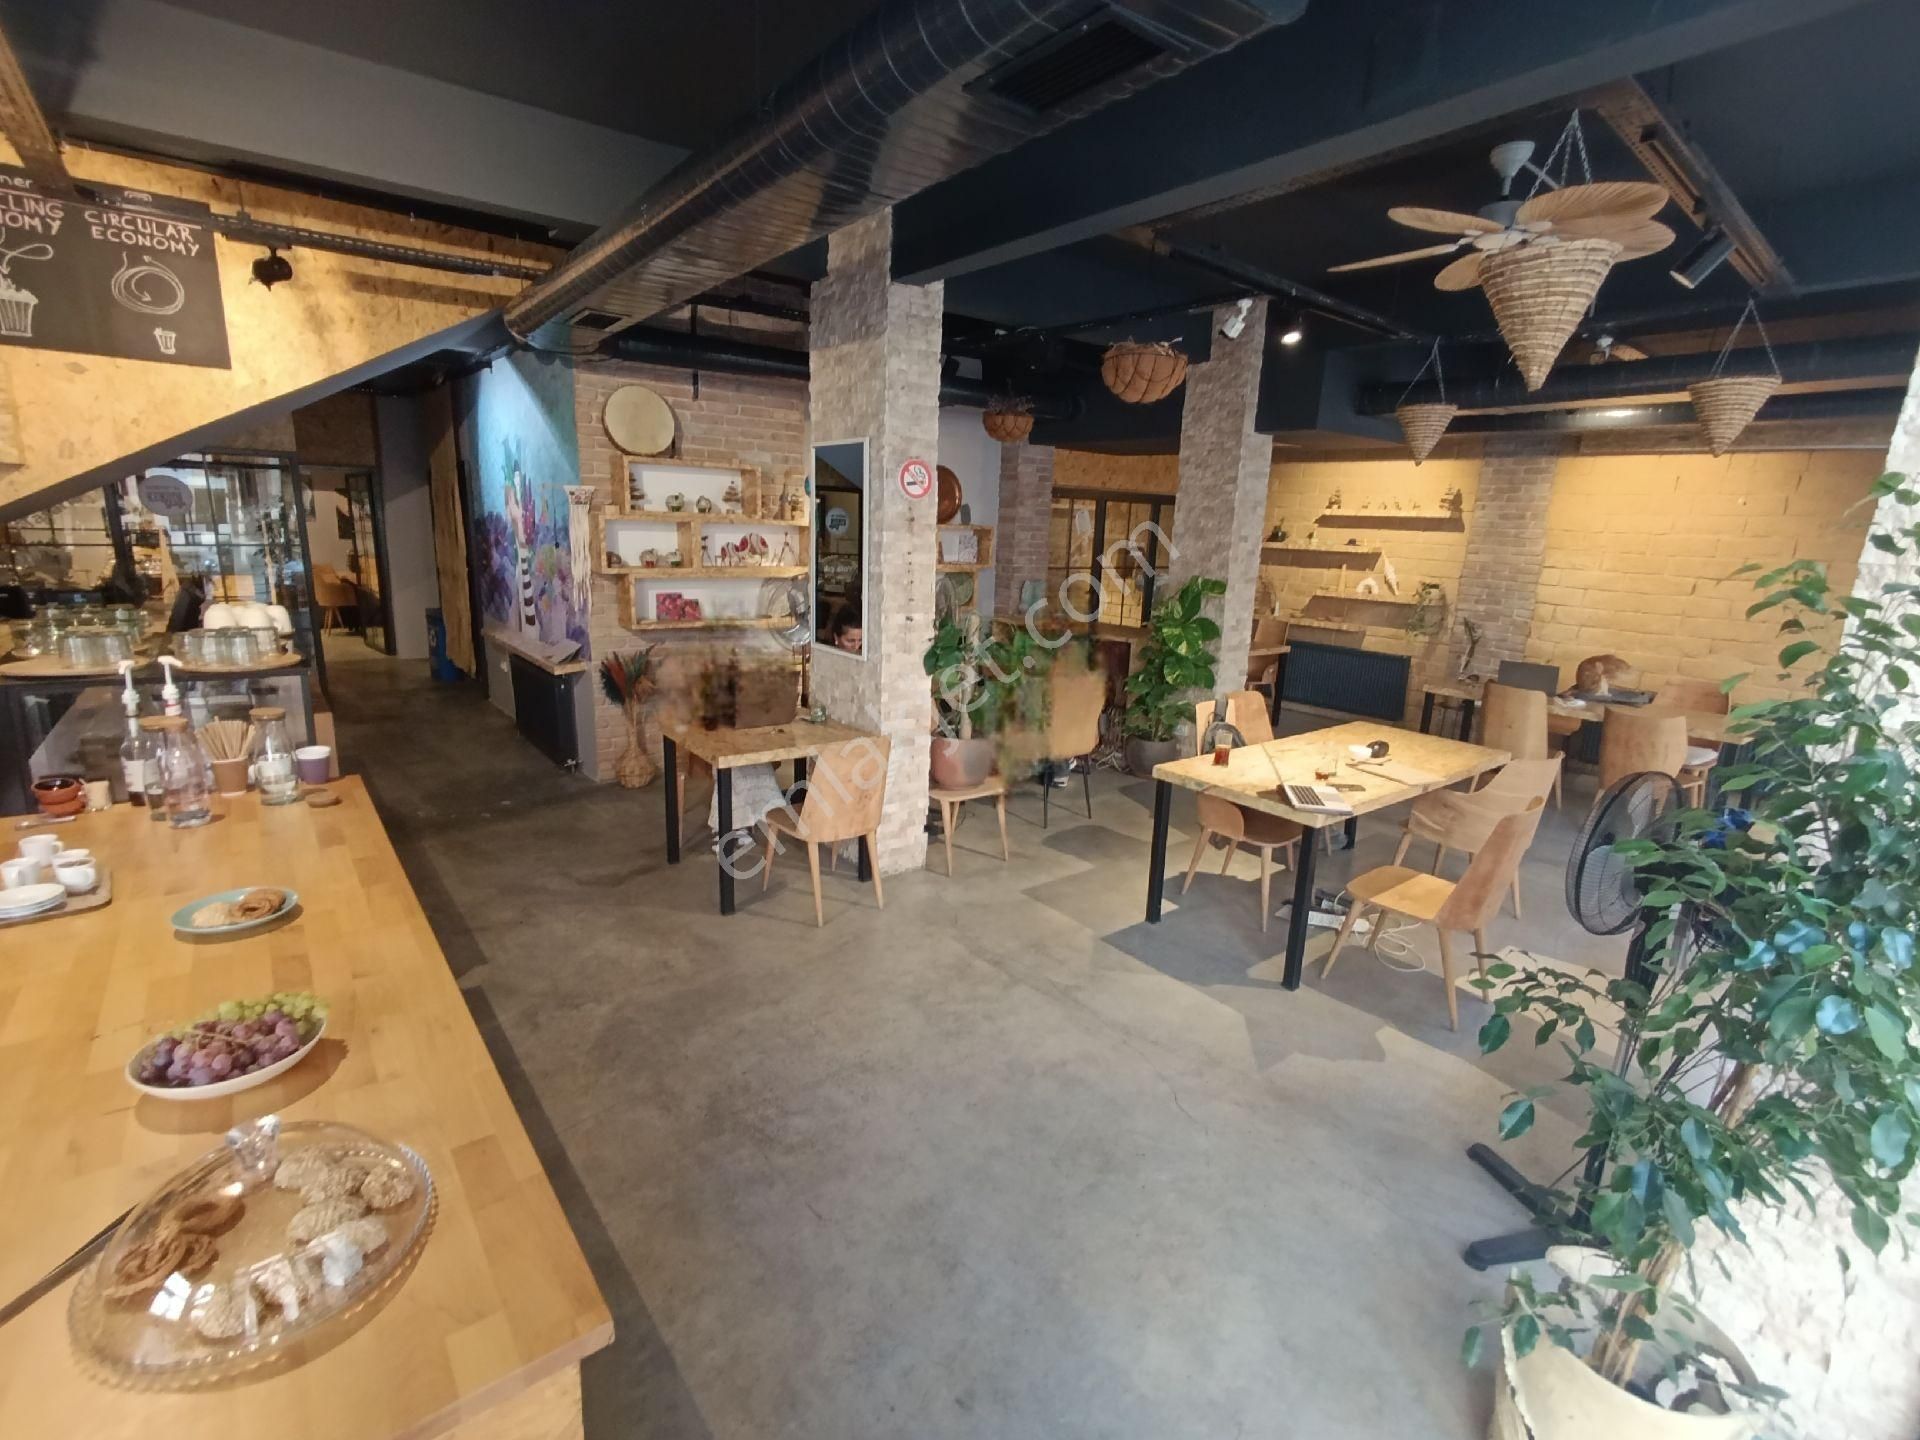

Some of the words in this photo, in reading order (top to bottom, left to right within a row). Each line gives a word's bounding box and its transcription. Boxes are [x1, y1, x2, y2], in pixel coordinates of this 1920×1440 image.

[0, 209, 62, 235] OMY
[84, 209, 194, 242] CIRCULAR
[92, 227, 200, 257] ECONOMY
